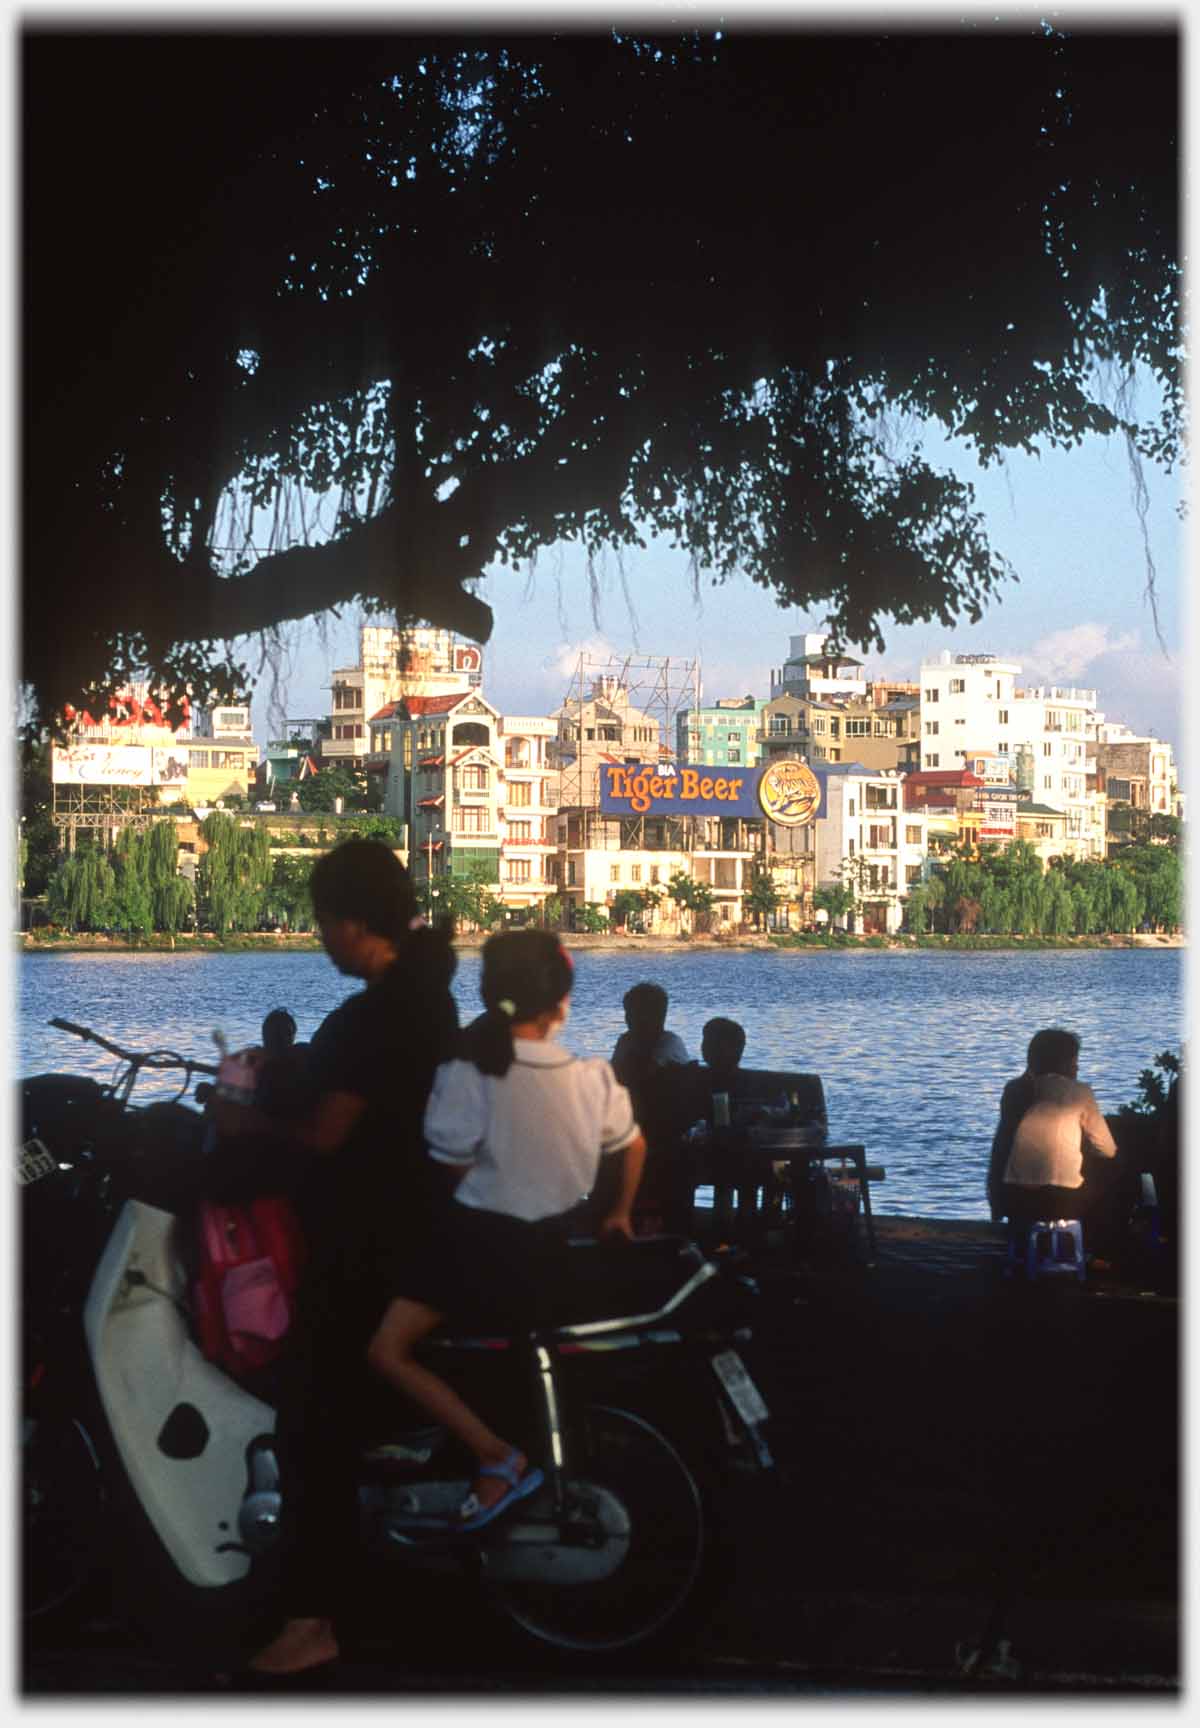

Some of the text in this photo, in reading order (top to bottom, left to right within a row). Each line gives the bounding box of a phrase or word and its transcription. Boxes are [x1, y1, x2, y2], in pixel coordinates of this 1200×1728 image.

[657, 765, 676, 777] BIA
[607, 767, 742, 812] Tiger Beer
